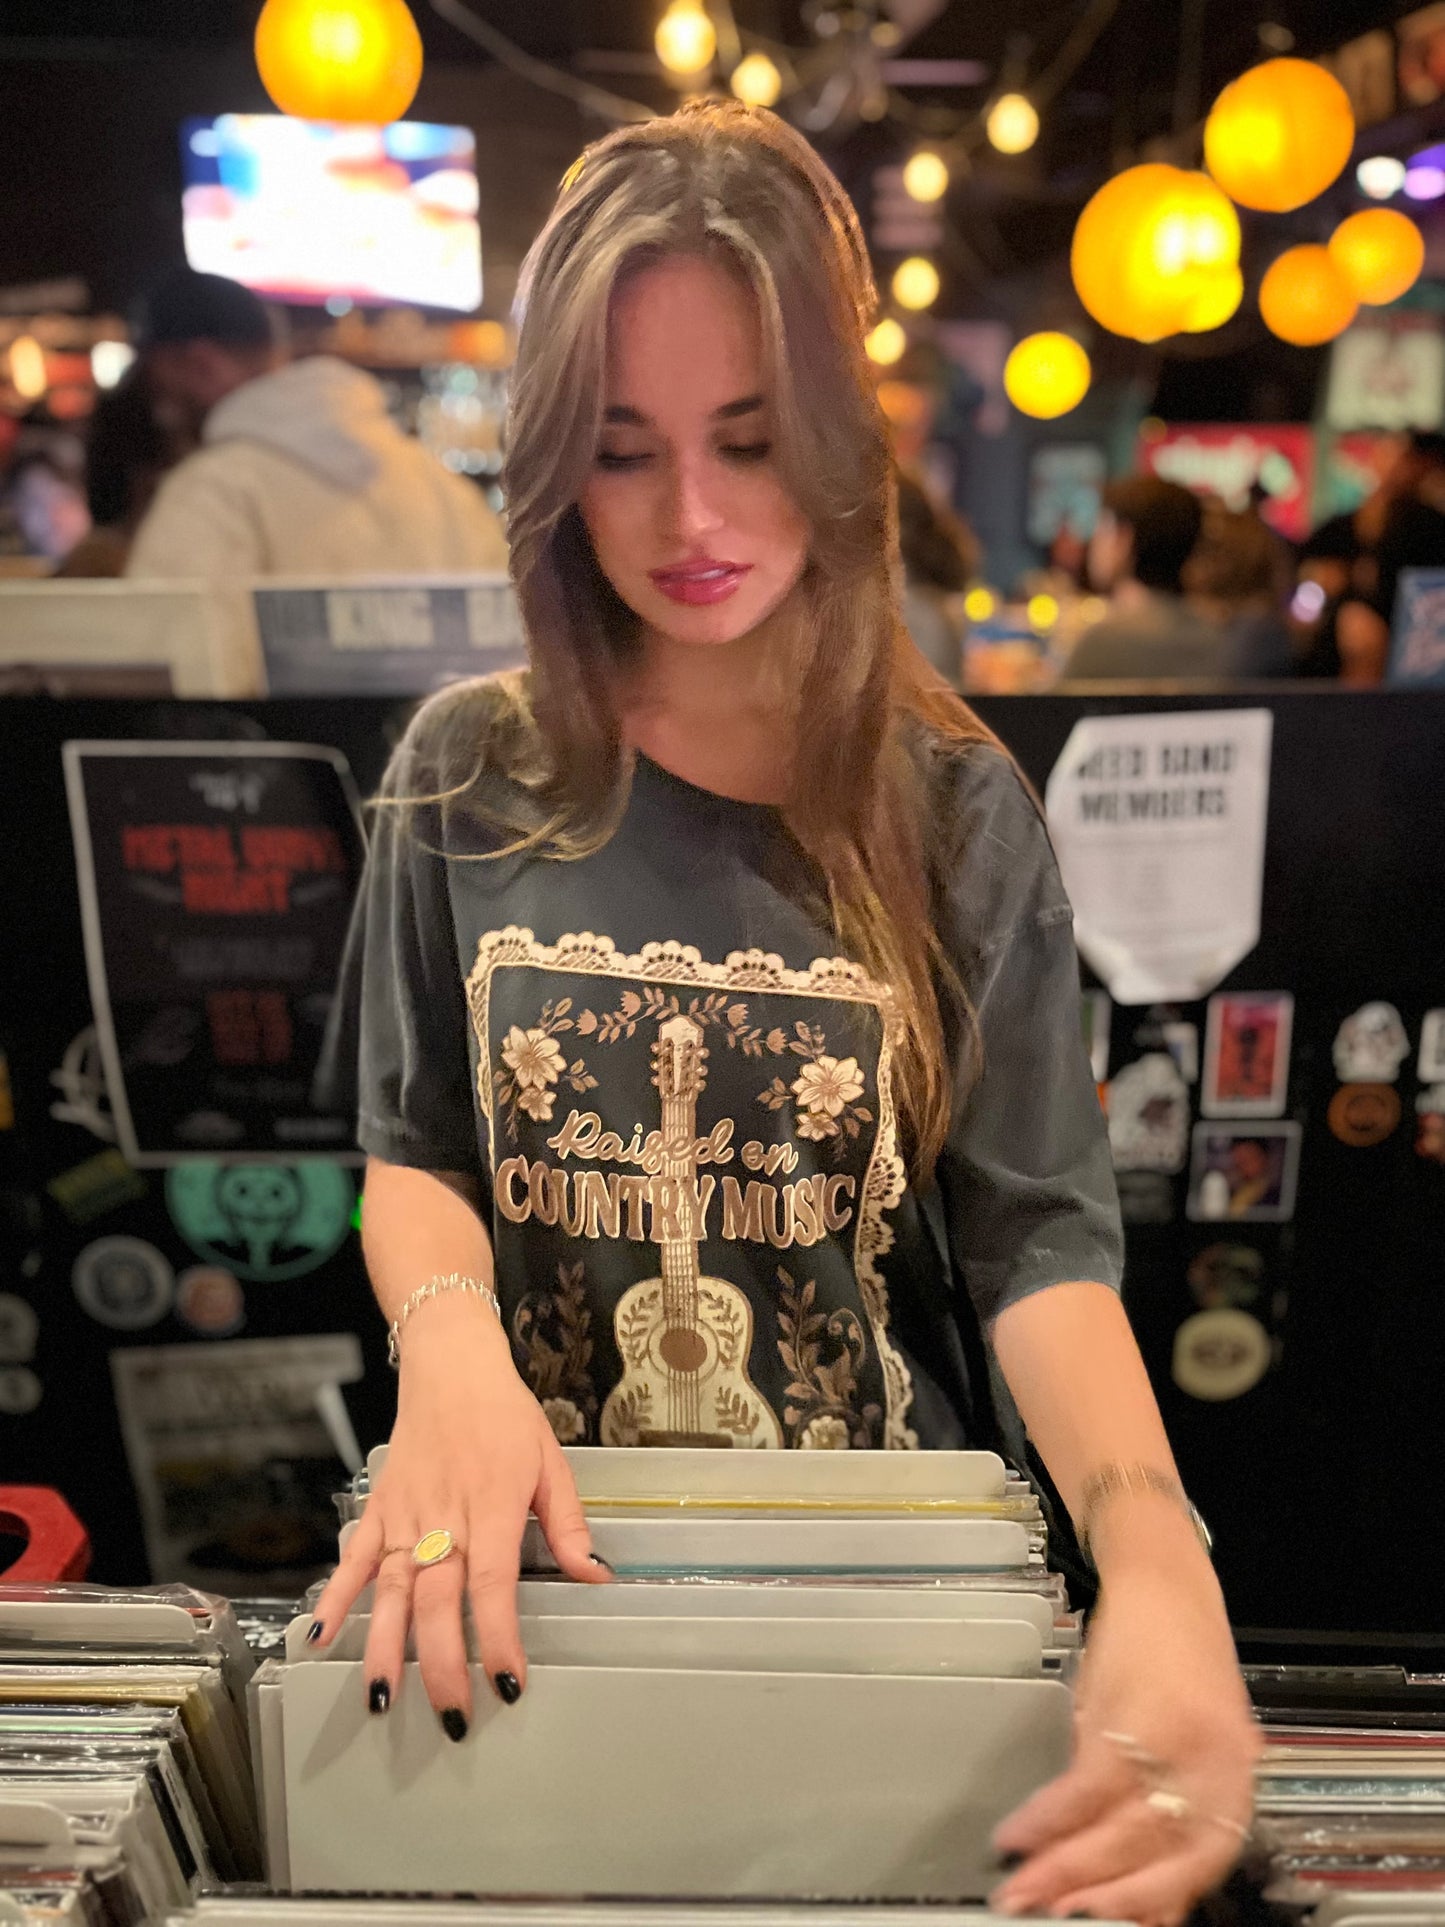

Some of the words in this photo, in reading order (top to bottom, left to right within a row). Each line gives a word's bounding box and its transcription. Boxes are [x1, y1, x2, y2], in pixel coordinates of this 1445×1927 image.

[547, 1109, 735, 1174] Raised
[740, 1140, 799, 1177] on
[495, 1154, 717, 1243] COUNTRY
[721, 1173, 855, 1249] MUSIC
